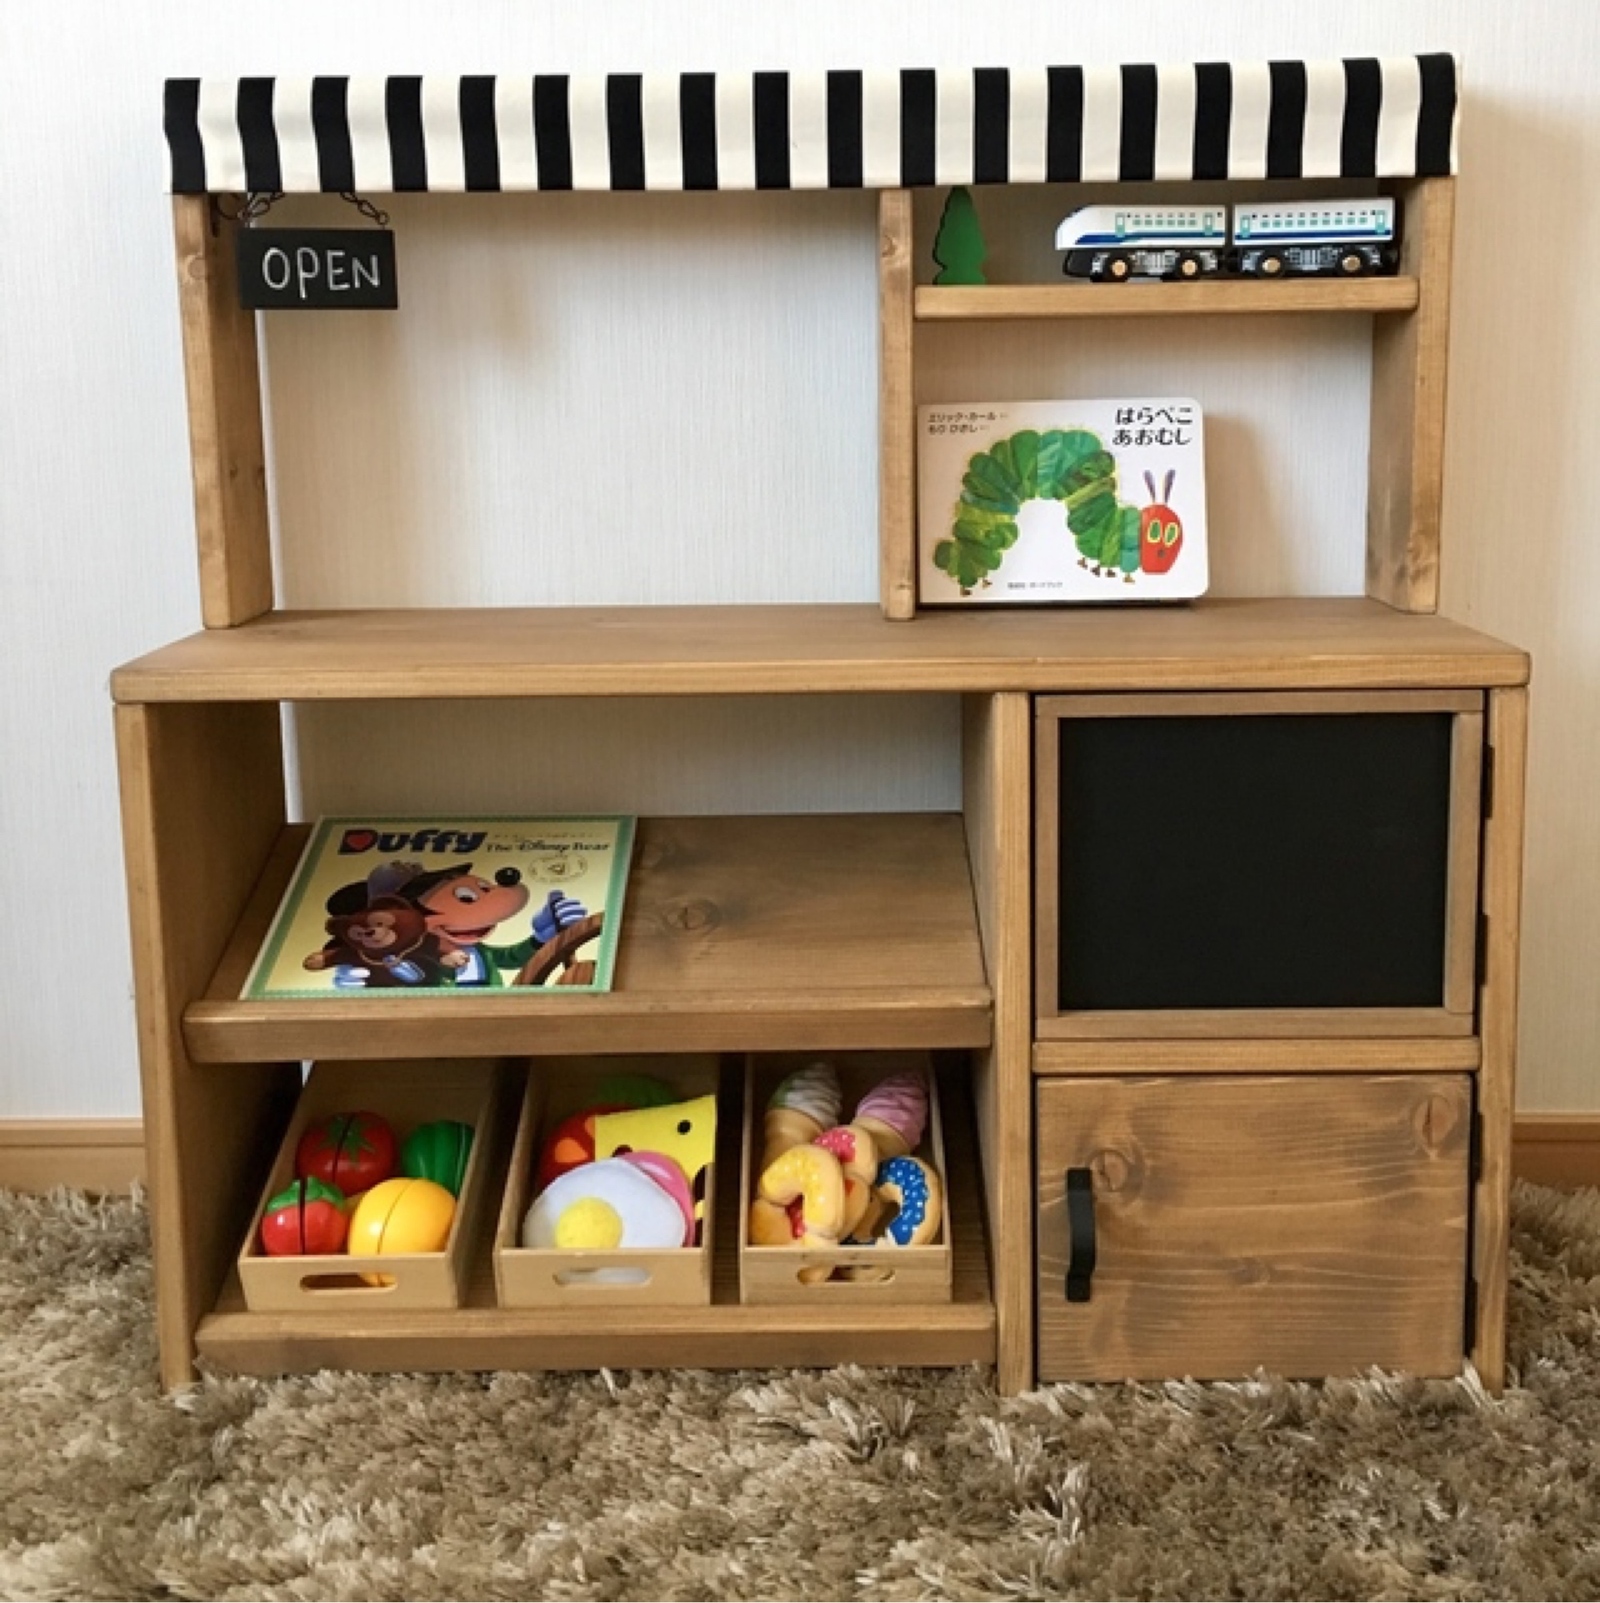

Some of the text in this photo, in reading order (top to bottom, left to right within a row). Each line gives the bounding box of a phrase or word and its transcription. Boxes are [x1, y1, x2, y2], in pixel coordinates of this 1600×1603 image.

[262, 247, 380, 300] OPEN
[1112, 427, 1193, 447] あおむし
[338, 829, 487, 854] Duffy
